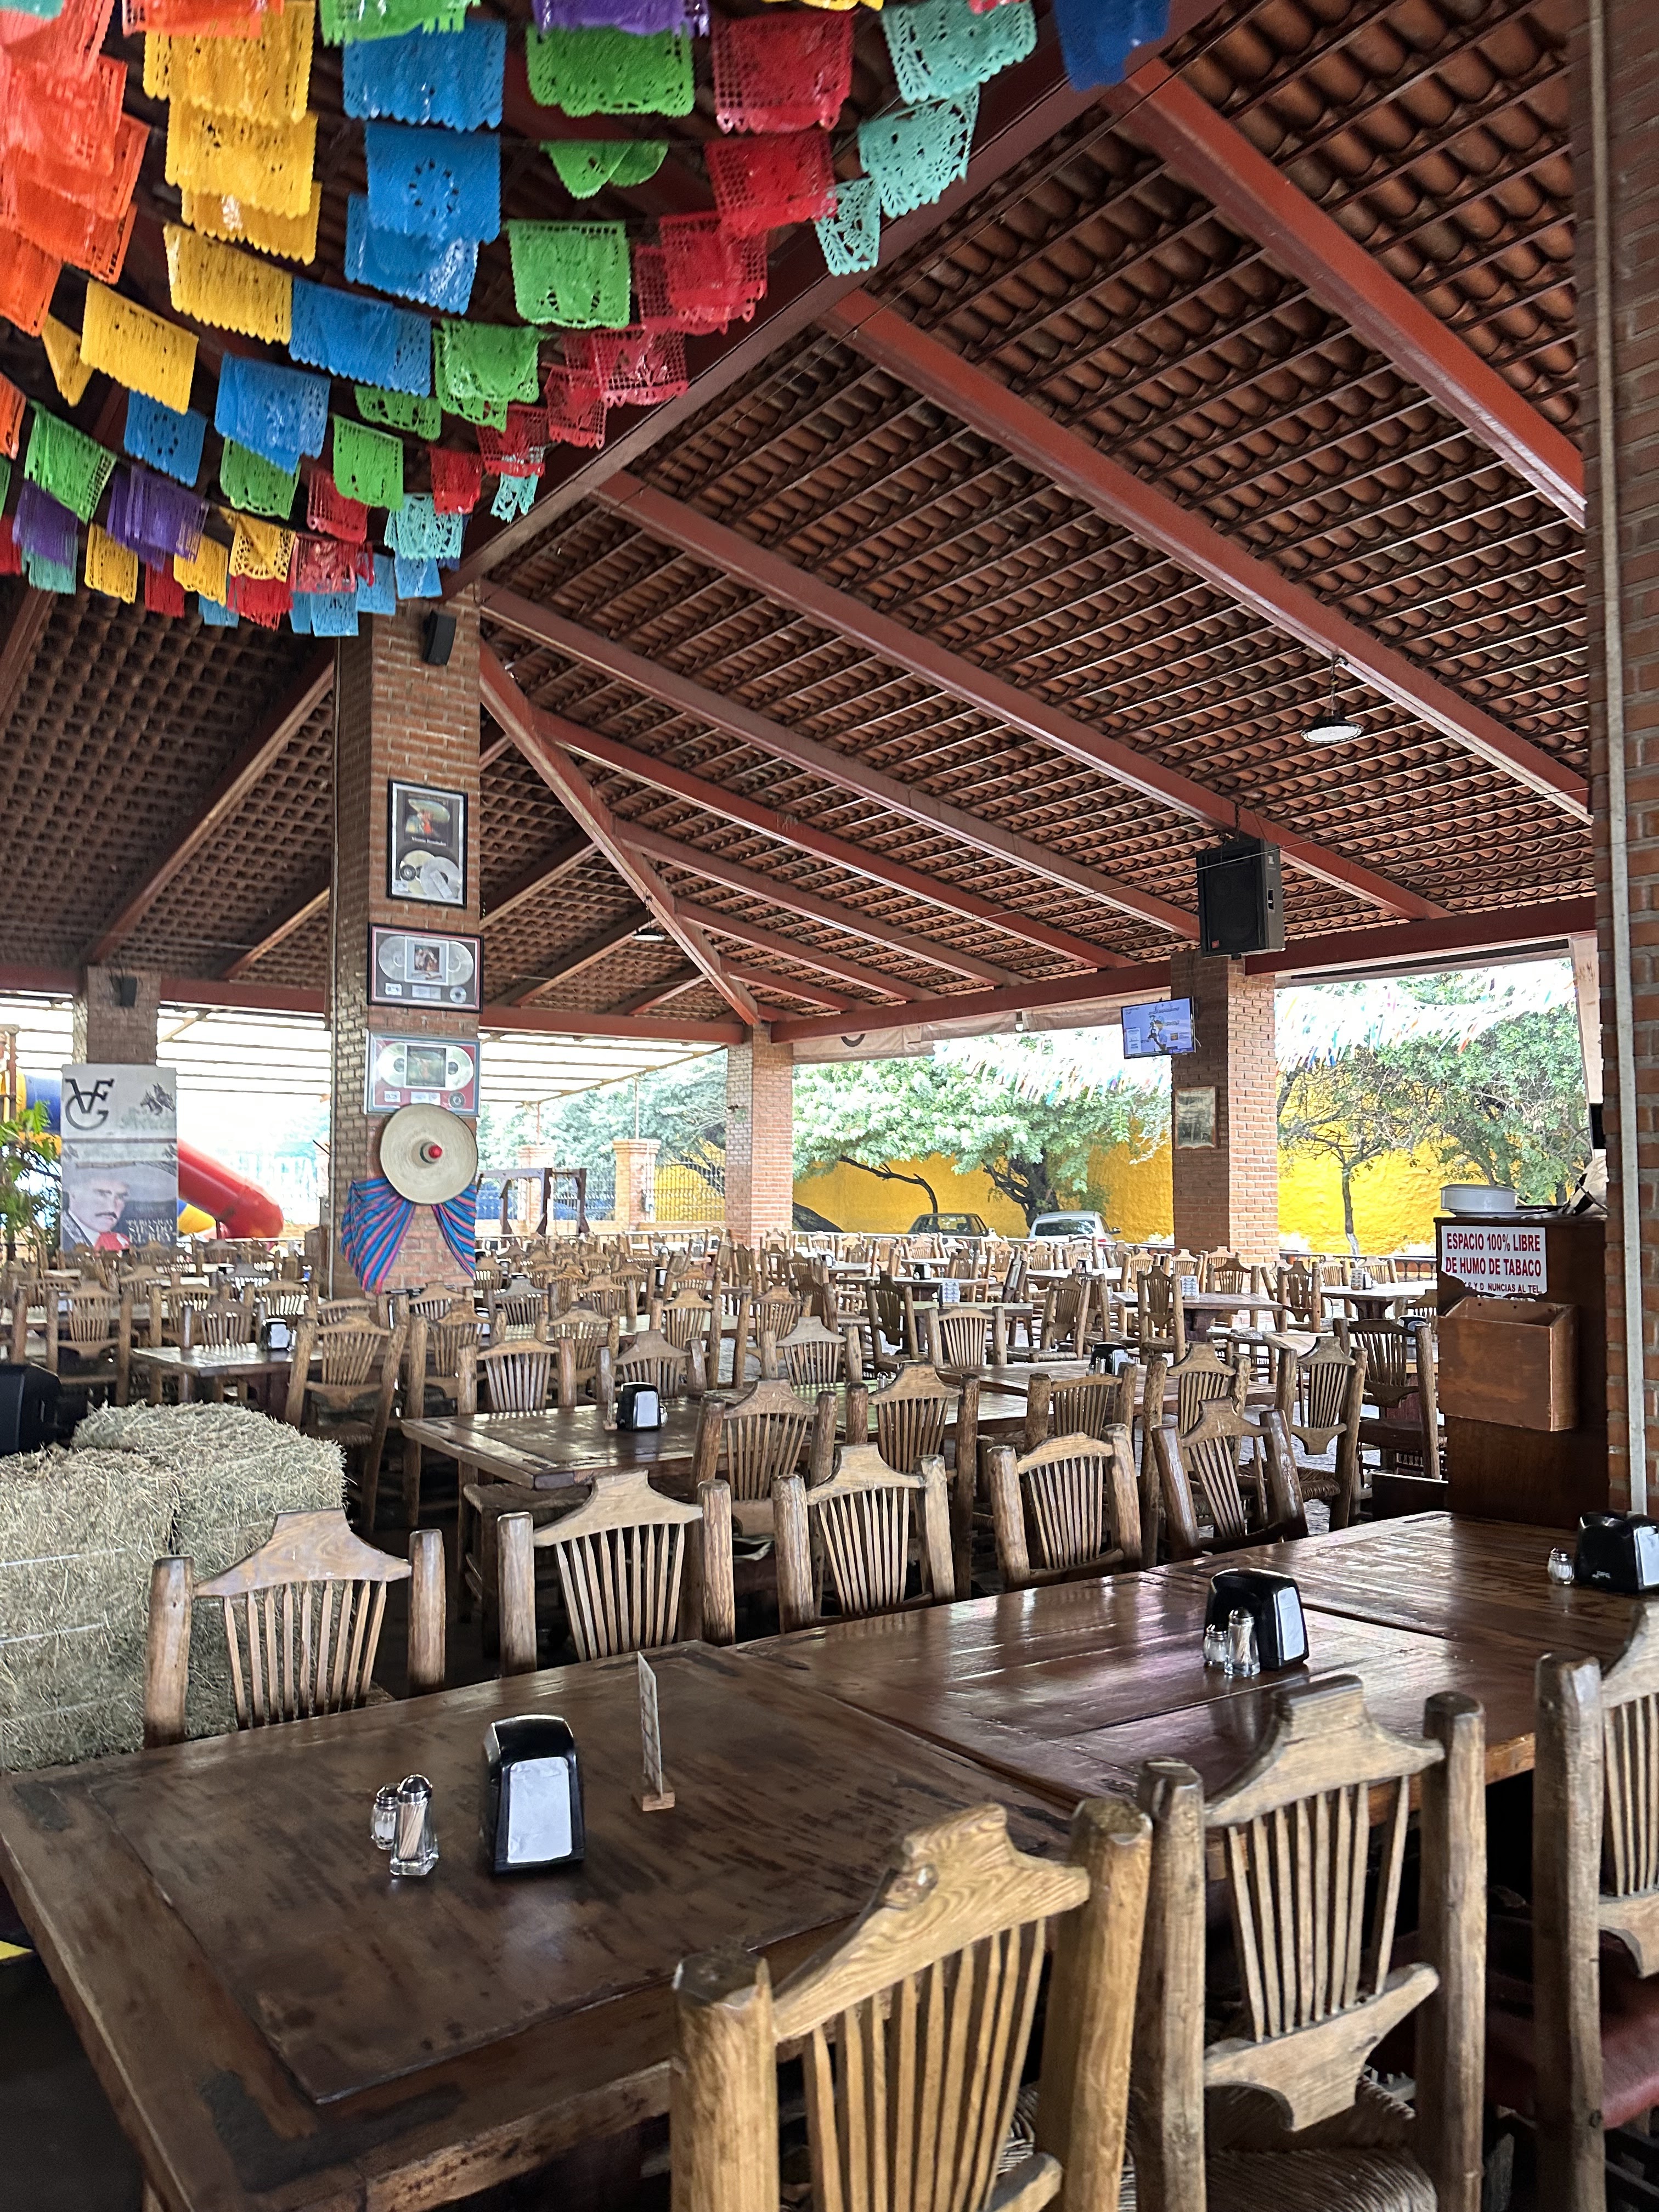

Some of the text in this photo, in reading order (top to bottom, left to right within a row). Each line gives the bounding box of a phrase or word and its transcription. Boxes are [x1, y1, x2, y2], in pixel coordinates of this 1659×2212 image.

[1447, 1233, 1541, 1251] ESPACIO 100% LIBRE
[1446, 1256, 1542, 1277] DE HUMO DE TABACO
[1518, 1284, 1527, 1293] AL
